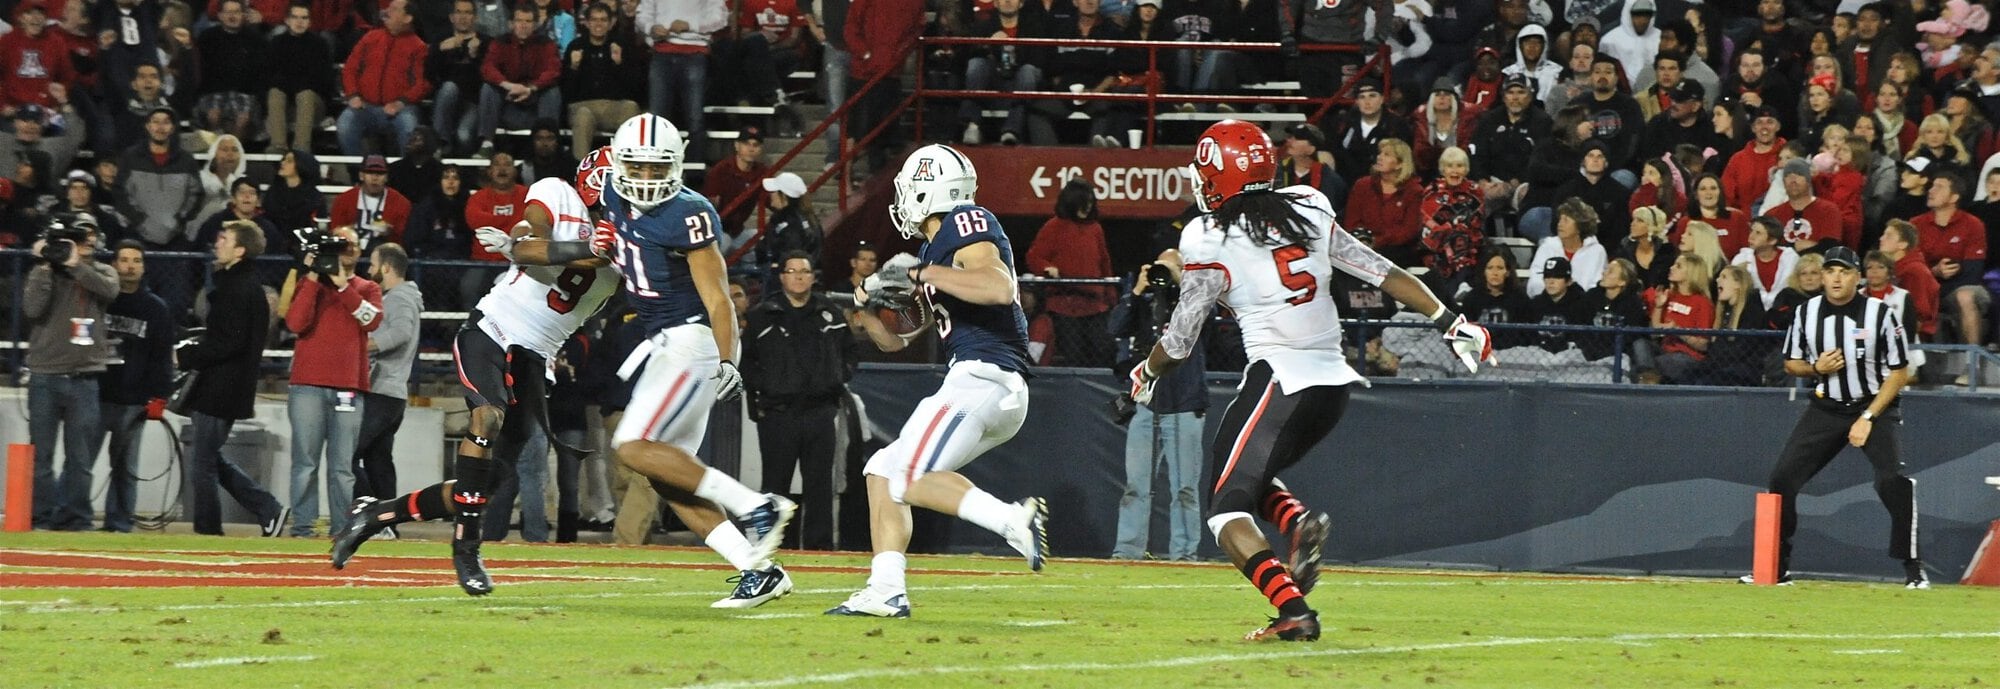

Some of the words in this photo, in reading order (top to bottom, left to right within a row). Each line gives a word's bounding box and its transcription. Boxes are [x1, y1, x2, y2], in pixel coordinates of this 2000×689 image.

[912, 158, 935, 181] A
[1093, 166, 1182, 201] SECTIO
[684, 211, 715, 245] 21
[954, 209, 988, 238] 85
[546, 265, 597, 316] 9
[1271, 242, 1318, 306] 5
[923, 281, 952, 340] 5
